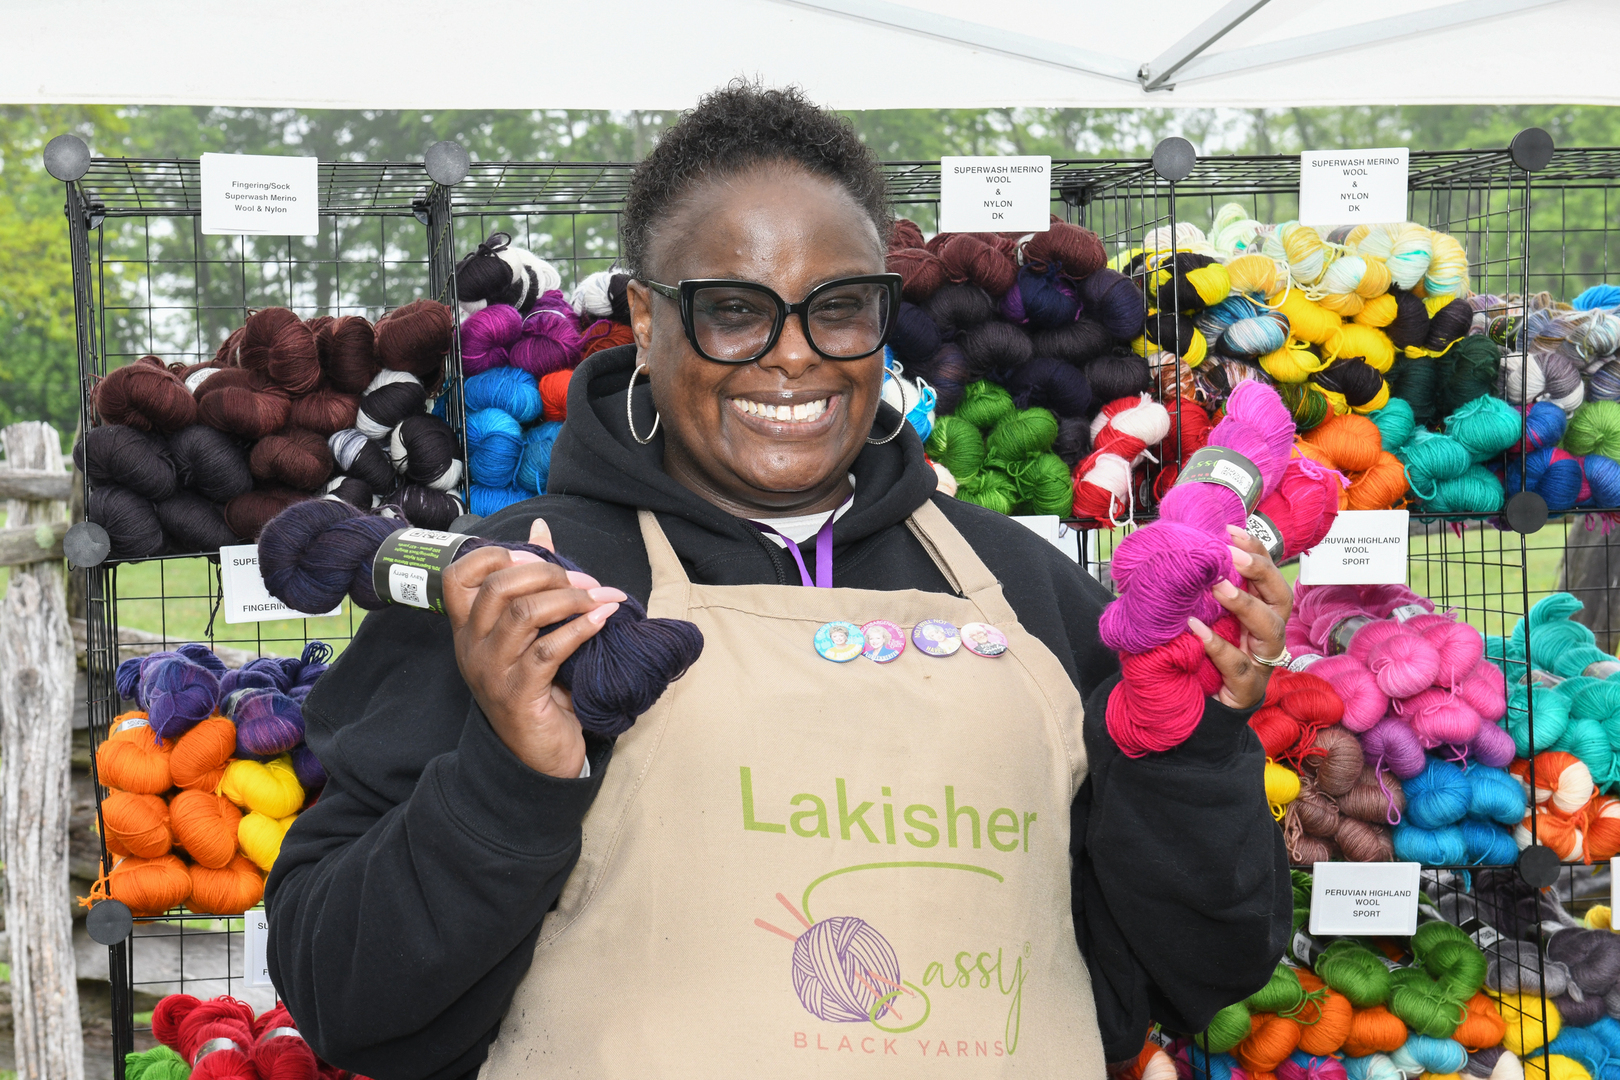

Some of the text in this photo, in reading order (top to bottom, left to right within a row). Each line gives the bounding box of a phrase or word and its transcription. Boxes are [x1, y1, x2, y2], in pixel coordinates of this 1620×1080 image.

[1312, 159, 1365, 167] SUPERWASH
[232, 181, 290, 190] Fingering/Sock
[393, 570, 424, 581] Navy Berry
[243, 603, 286, 612] FINGERIN
[739, 766, 1037, 852] Lakisher
[794, 1032, 1004, 1057] BLACK YARNS
